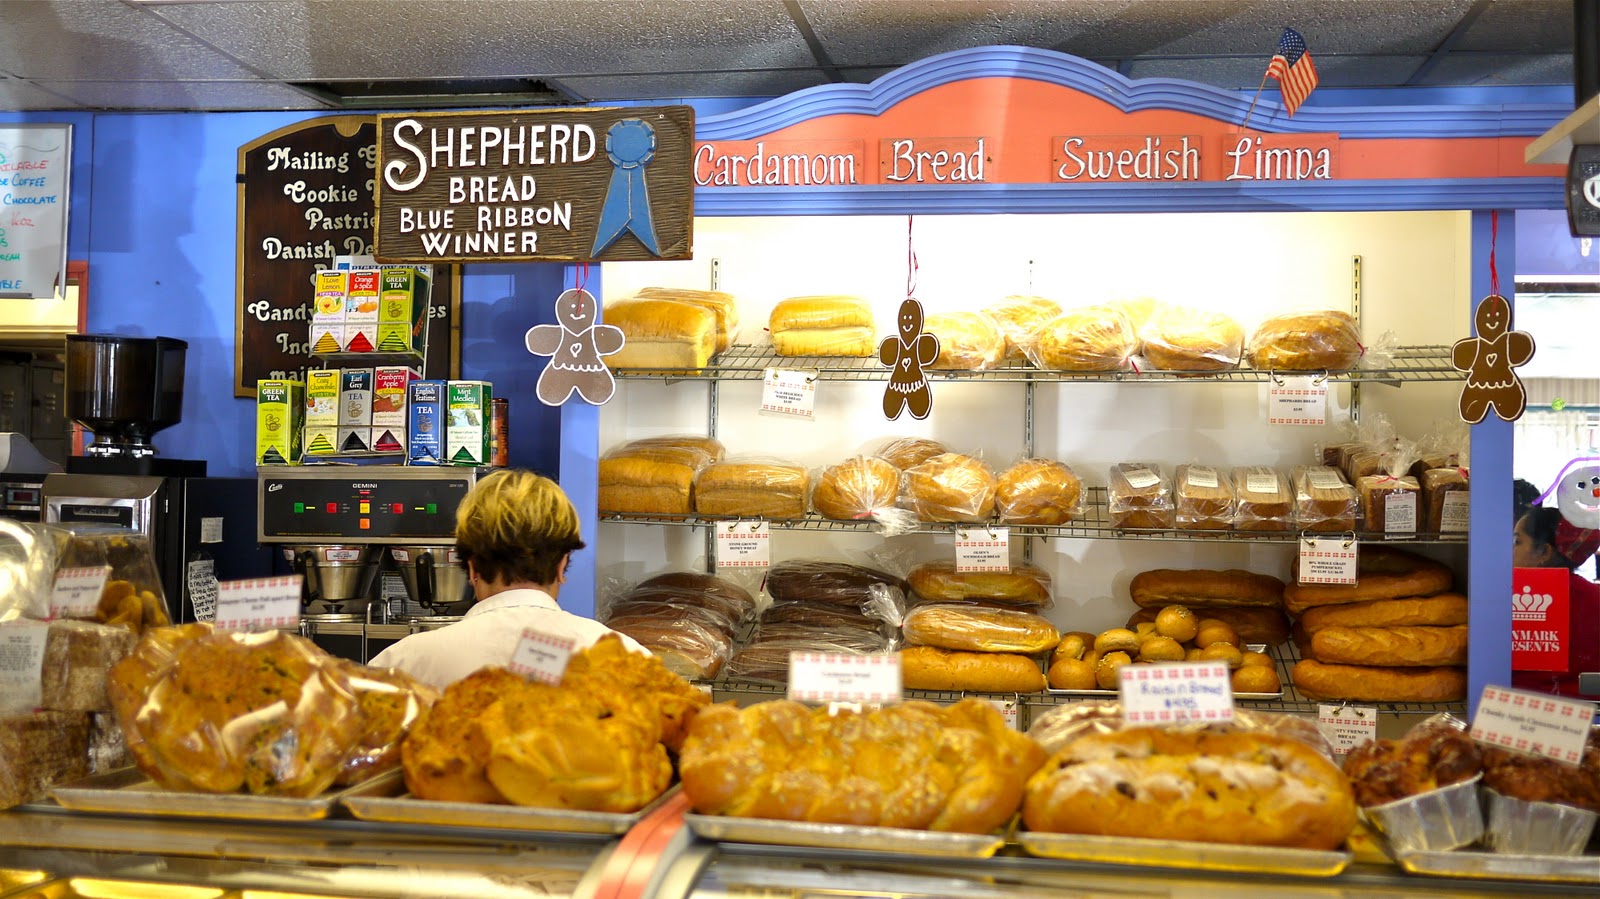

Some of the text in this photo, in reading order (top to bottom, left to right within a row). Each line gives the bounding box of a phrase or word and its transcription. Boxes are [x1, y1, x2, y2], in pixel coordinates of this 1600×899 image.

[267, 147, 350, 173] Mailing
[384, 119, 596, 192] SHEPHERD
[693, 136, 1333, 186] Cardamom Bread Swedish Limpa
[283, 180, 358, 203] Cookie
[449, 175, 536, 204] BREAD
[3, 193, 57, 205] CHOCOLATE
[400, 202, 572, 233] BLUE RIBBON
[262, 236, 336, 260] Danish
[420, 231, 538, 257] WINNER
[354, 276, 374, 285] Orange
[247, 300, 314, 325] Candy
[349, 382, 363, 390] Grey
[377, 373, 405, 383] Cranberry
[382, 380, 398, 389] Apple
[415, 387, 435, 395] English
[415, 394, 436, 402] Teatime
[453, 395, 476, 404] Medley
[416, 406, 433, 414] TEA
